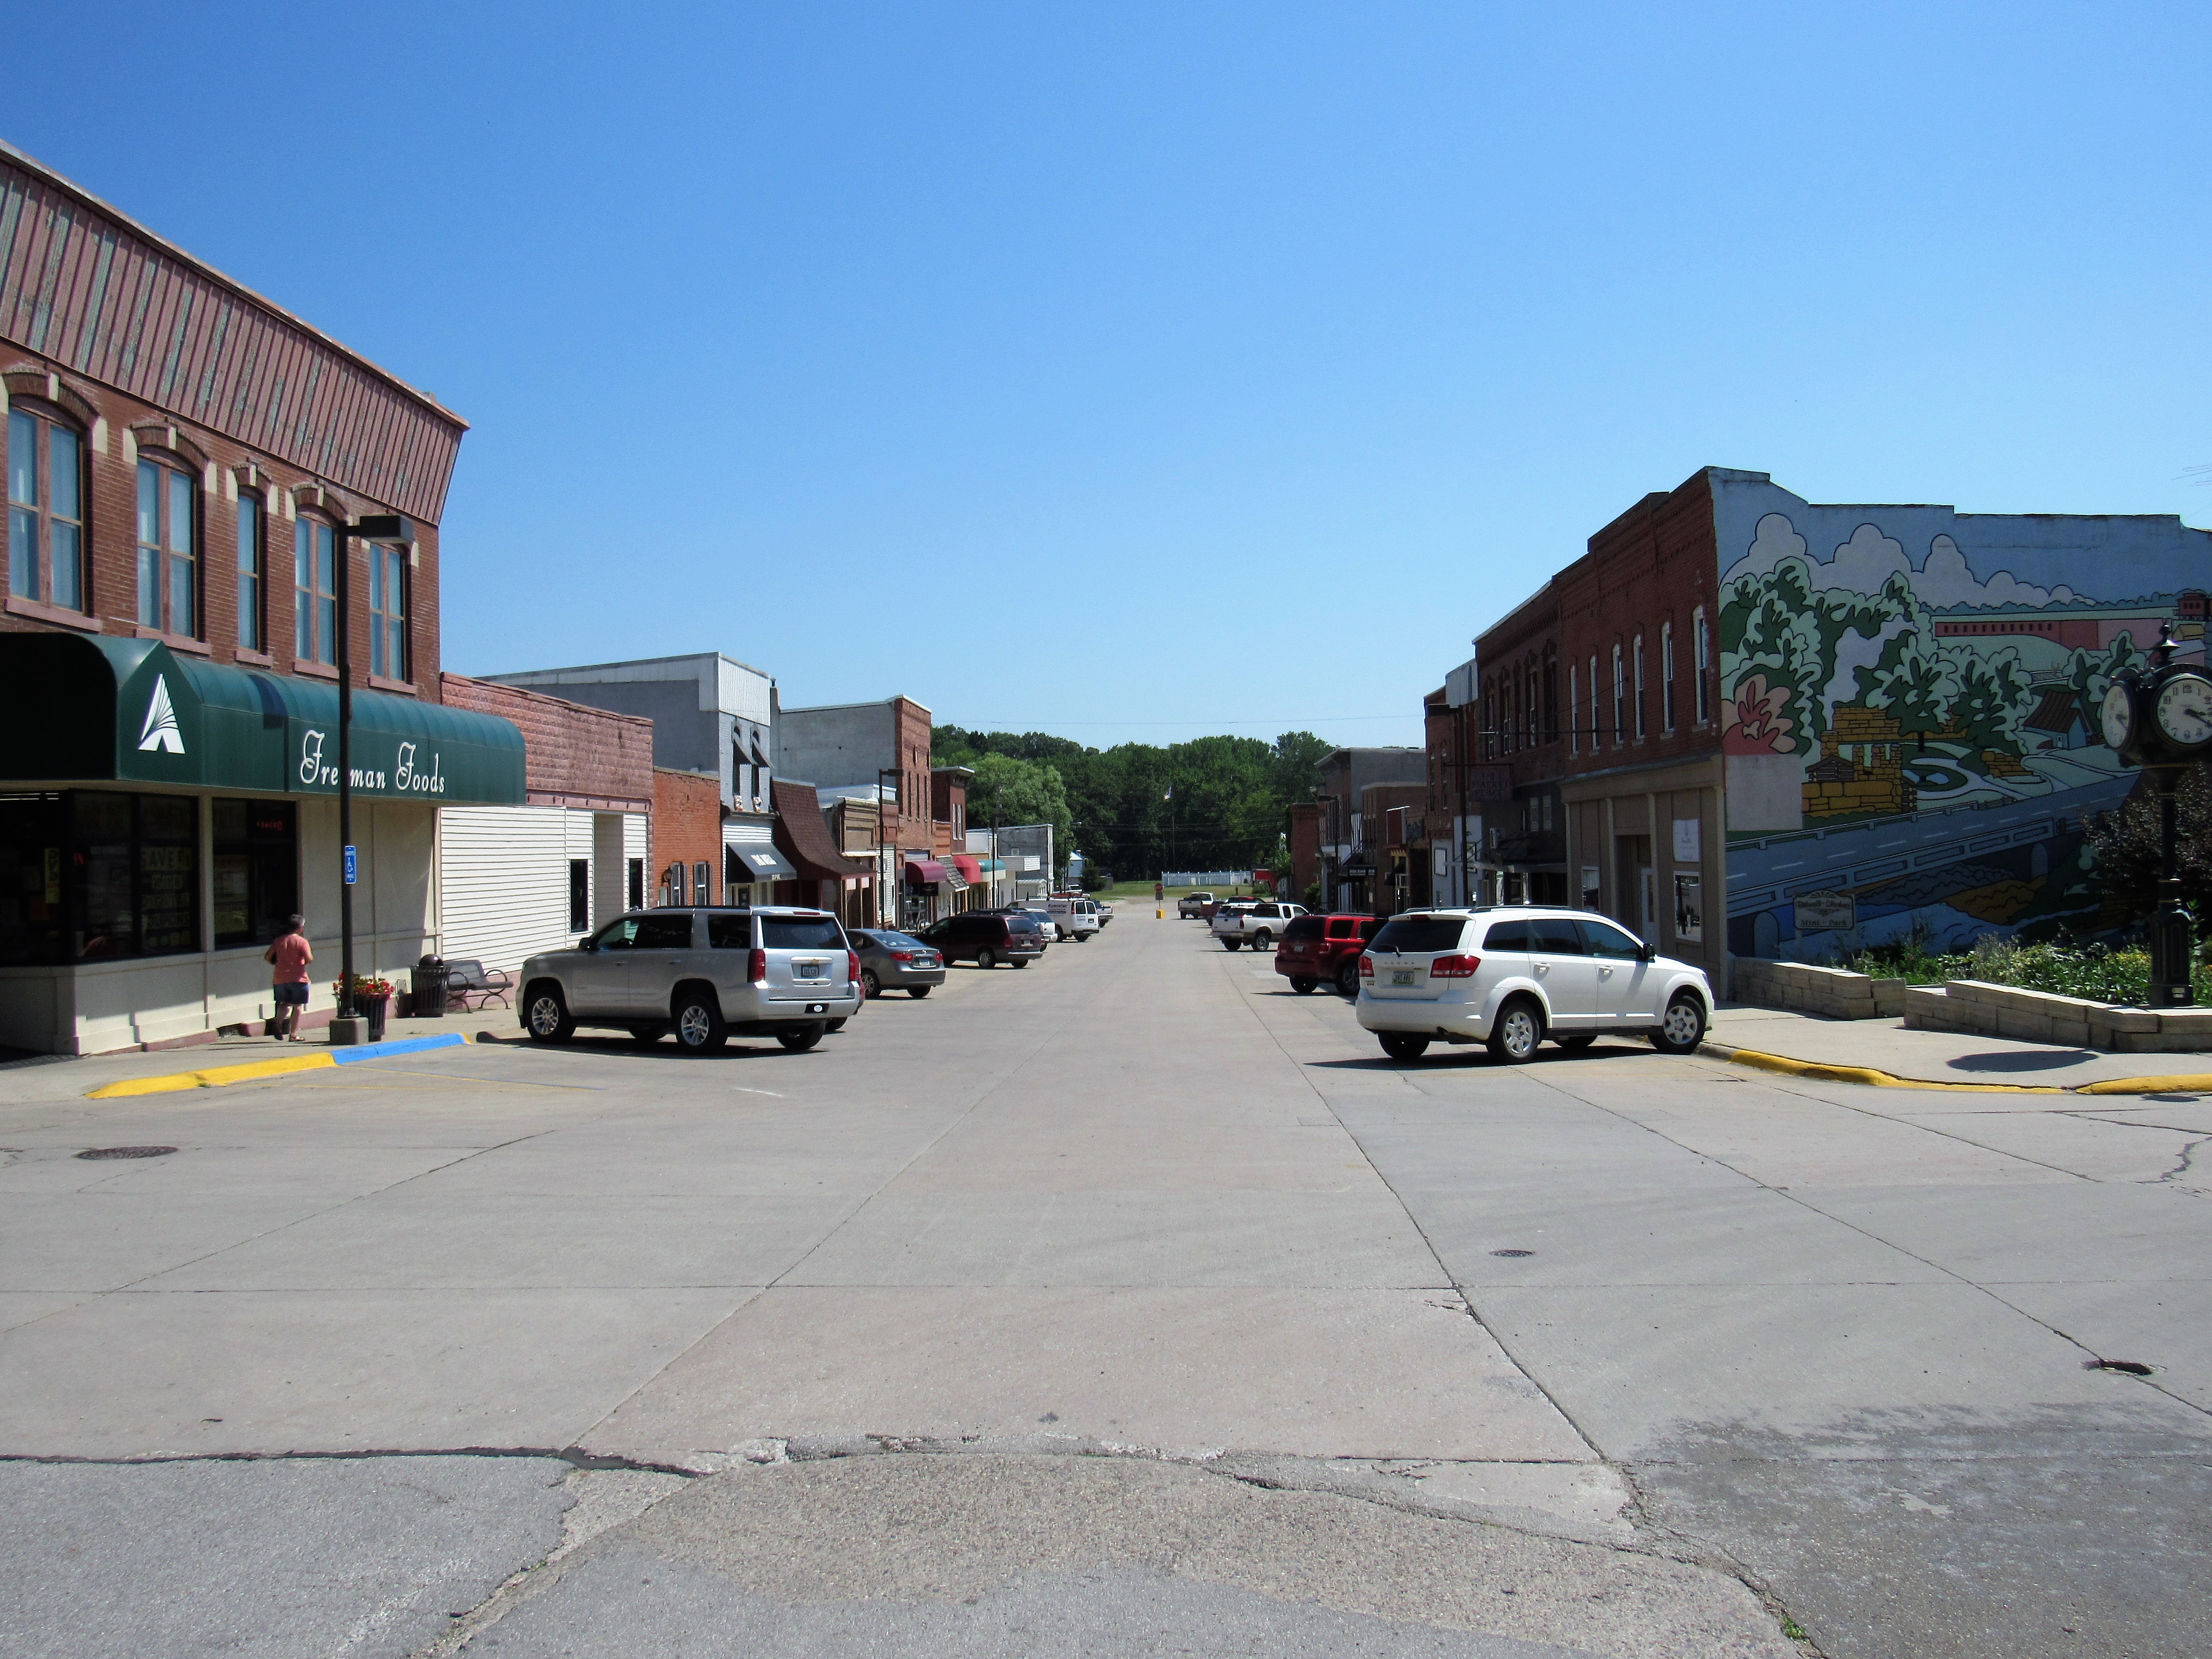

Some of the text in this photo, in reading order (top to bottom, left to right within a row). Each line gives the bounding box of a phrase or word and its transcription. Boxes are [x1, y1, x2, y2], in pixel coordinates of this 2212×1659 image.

[2183, 685, 2191, 693] 12
[2204, 696, 2212, 705] 2
[2171, 727, 2177, 736] 7
[301, 730, 445, 793] Freman Foods
